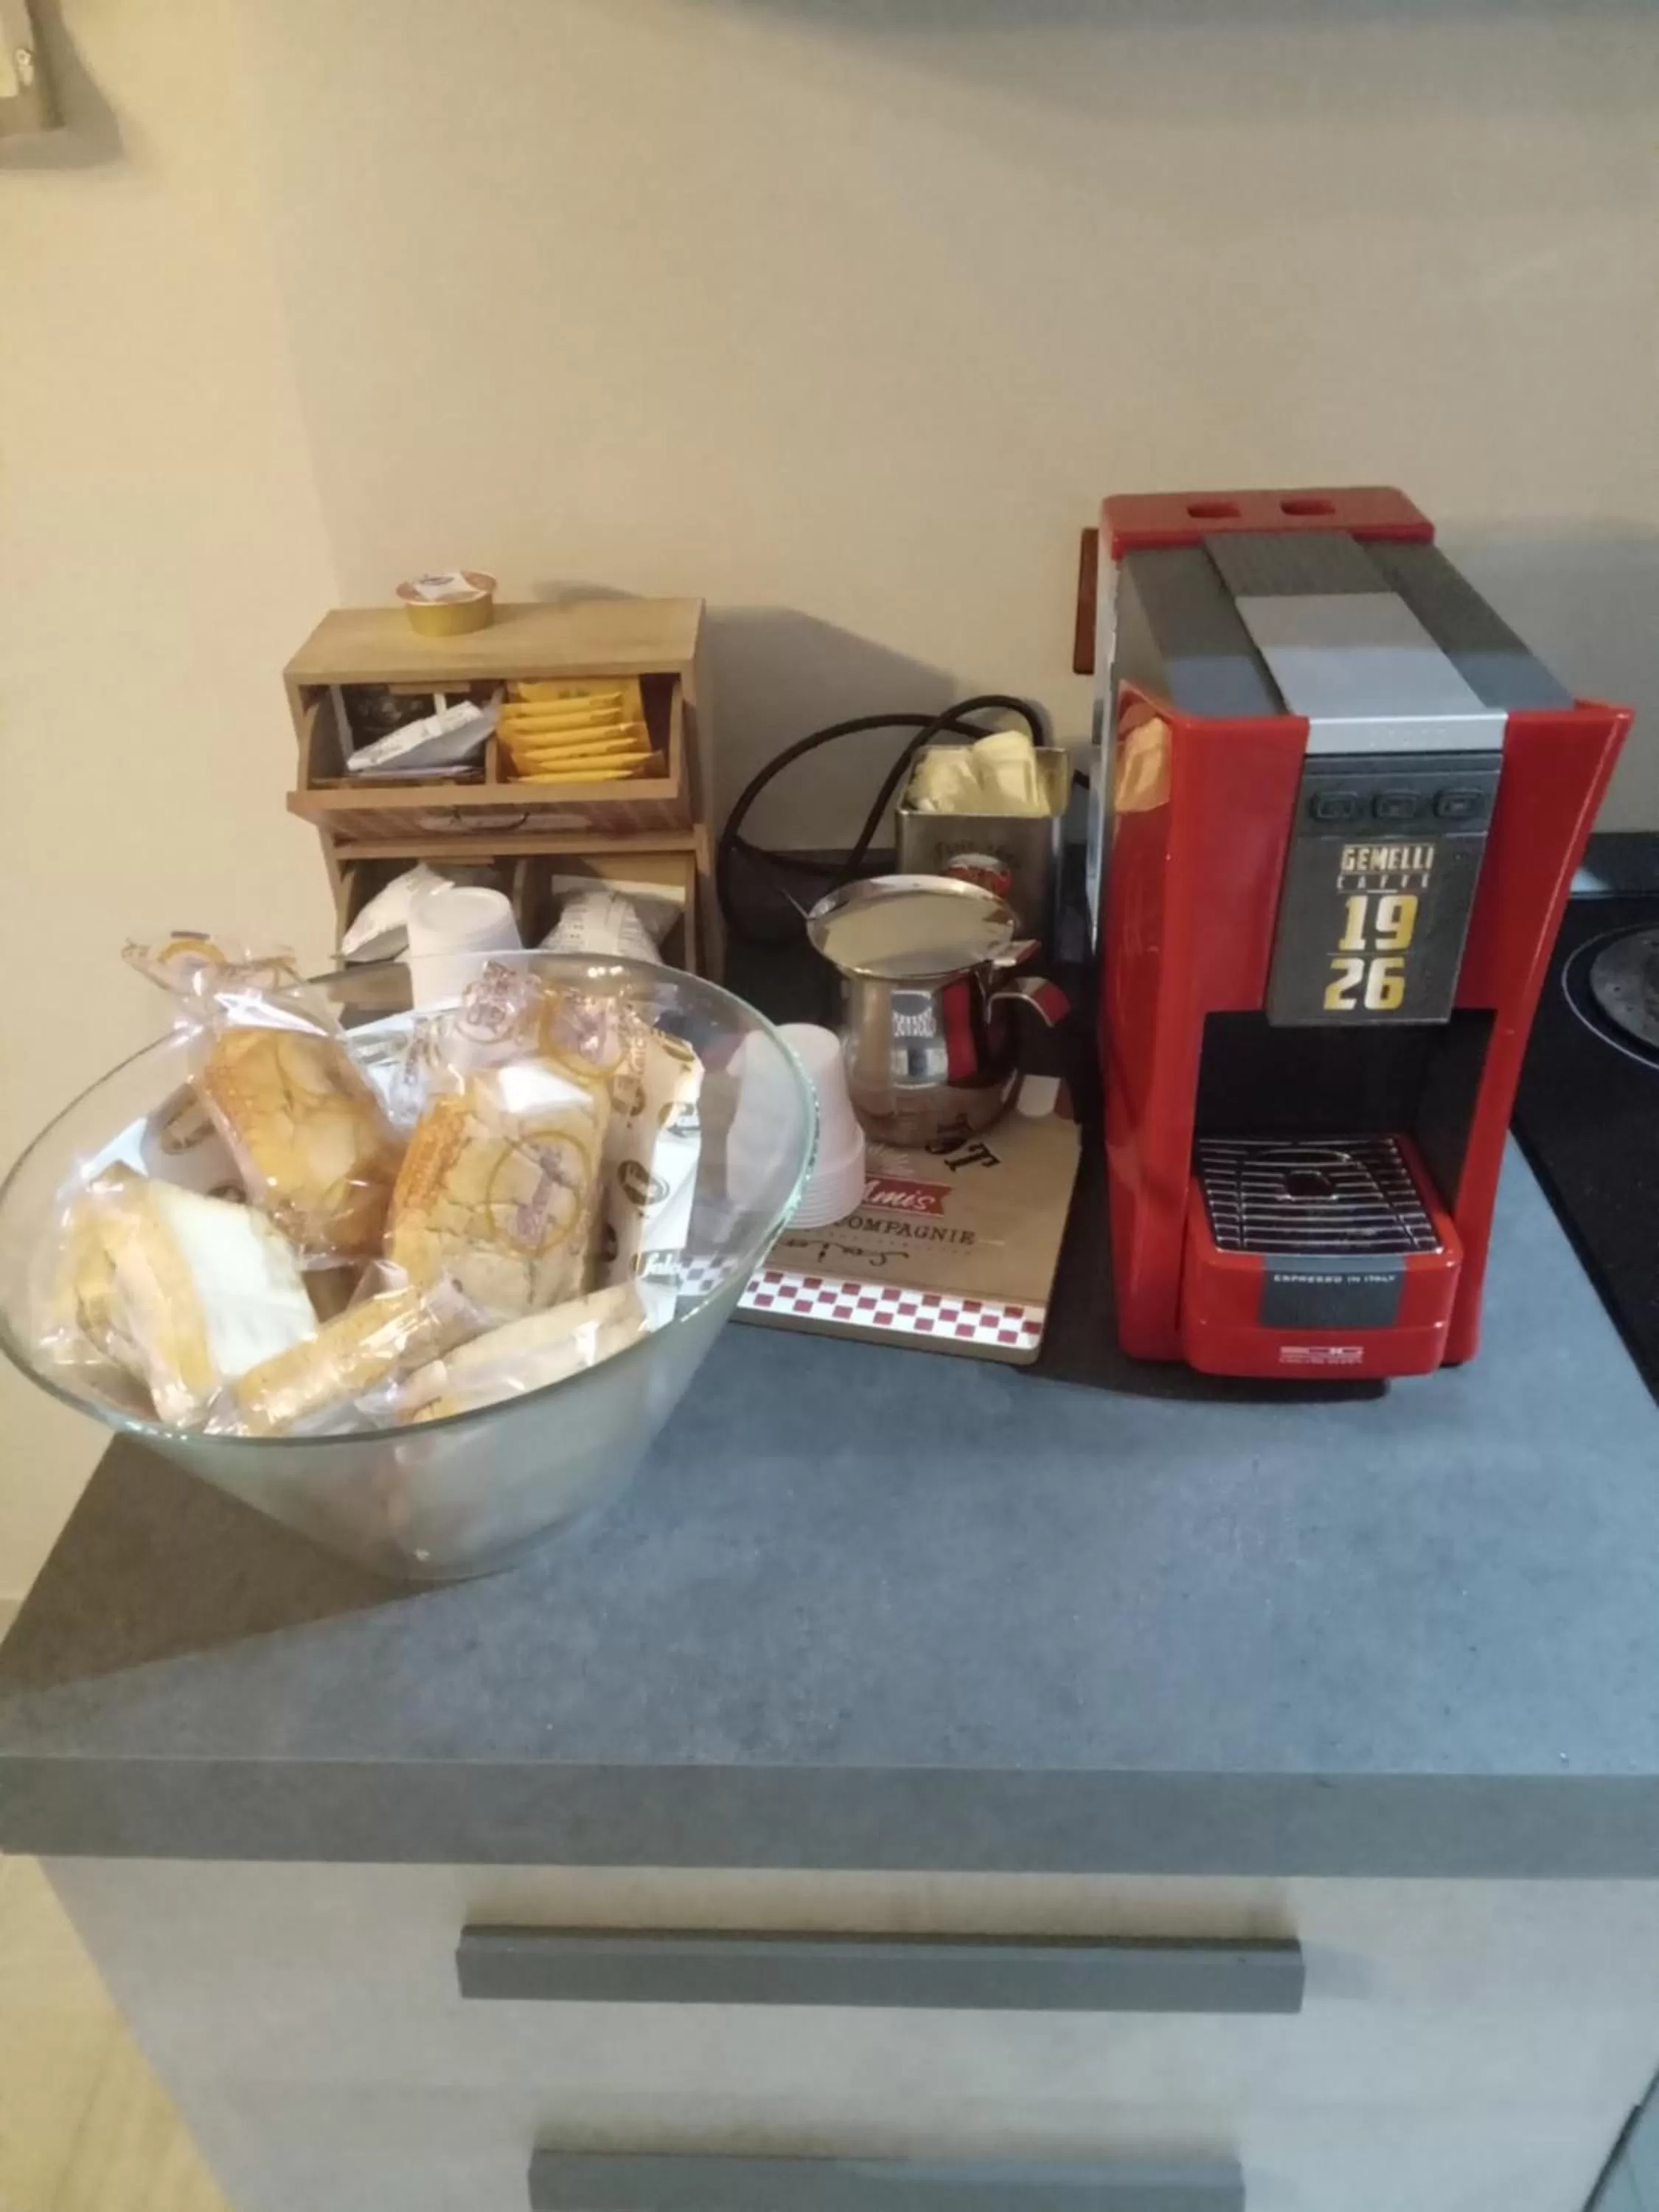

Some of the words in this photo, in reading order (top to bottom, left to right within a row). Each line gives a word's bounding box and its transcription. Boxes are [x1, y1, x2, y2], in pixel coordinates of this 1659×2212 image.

[1340, 846, 1436, 872] GEMELLI
[1338, 894, 1419, 951] 19
[1323, 956, 1406, 1011] 26
[1273, 1273, 1343, 1284] ESPRESSO
